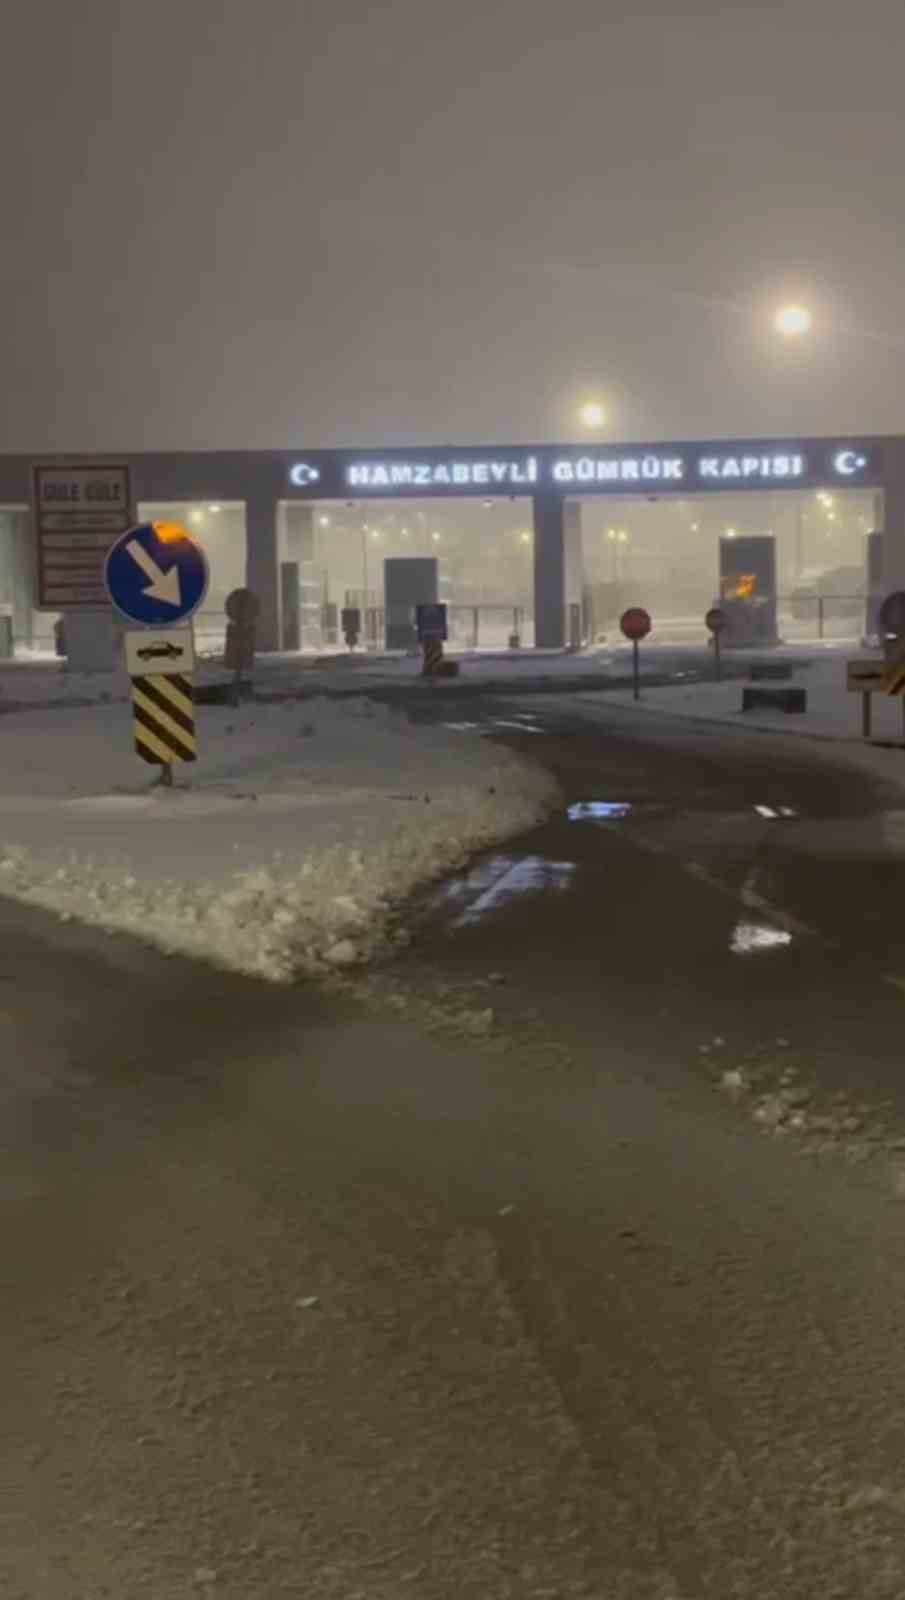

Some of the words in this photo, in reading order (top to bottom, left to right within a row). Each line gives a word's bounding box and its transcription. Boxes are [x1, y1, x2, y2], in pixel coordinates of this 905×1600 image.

[348, 457, 538, 484] HAMZABEYLİ
[552, 456, 684, 481] GÜMRÜK
[700, 455, 803, 477] KAPISI
